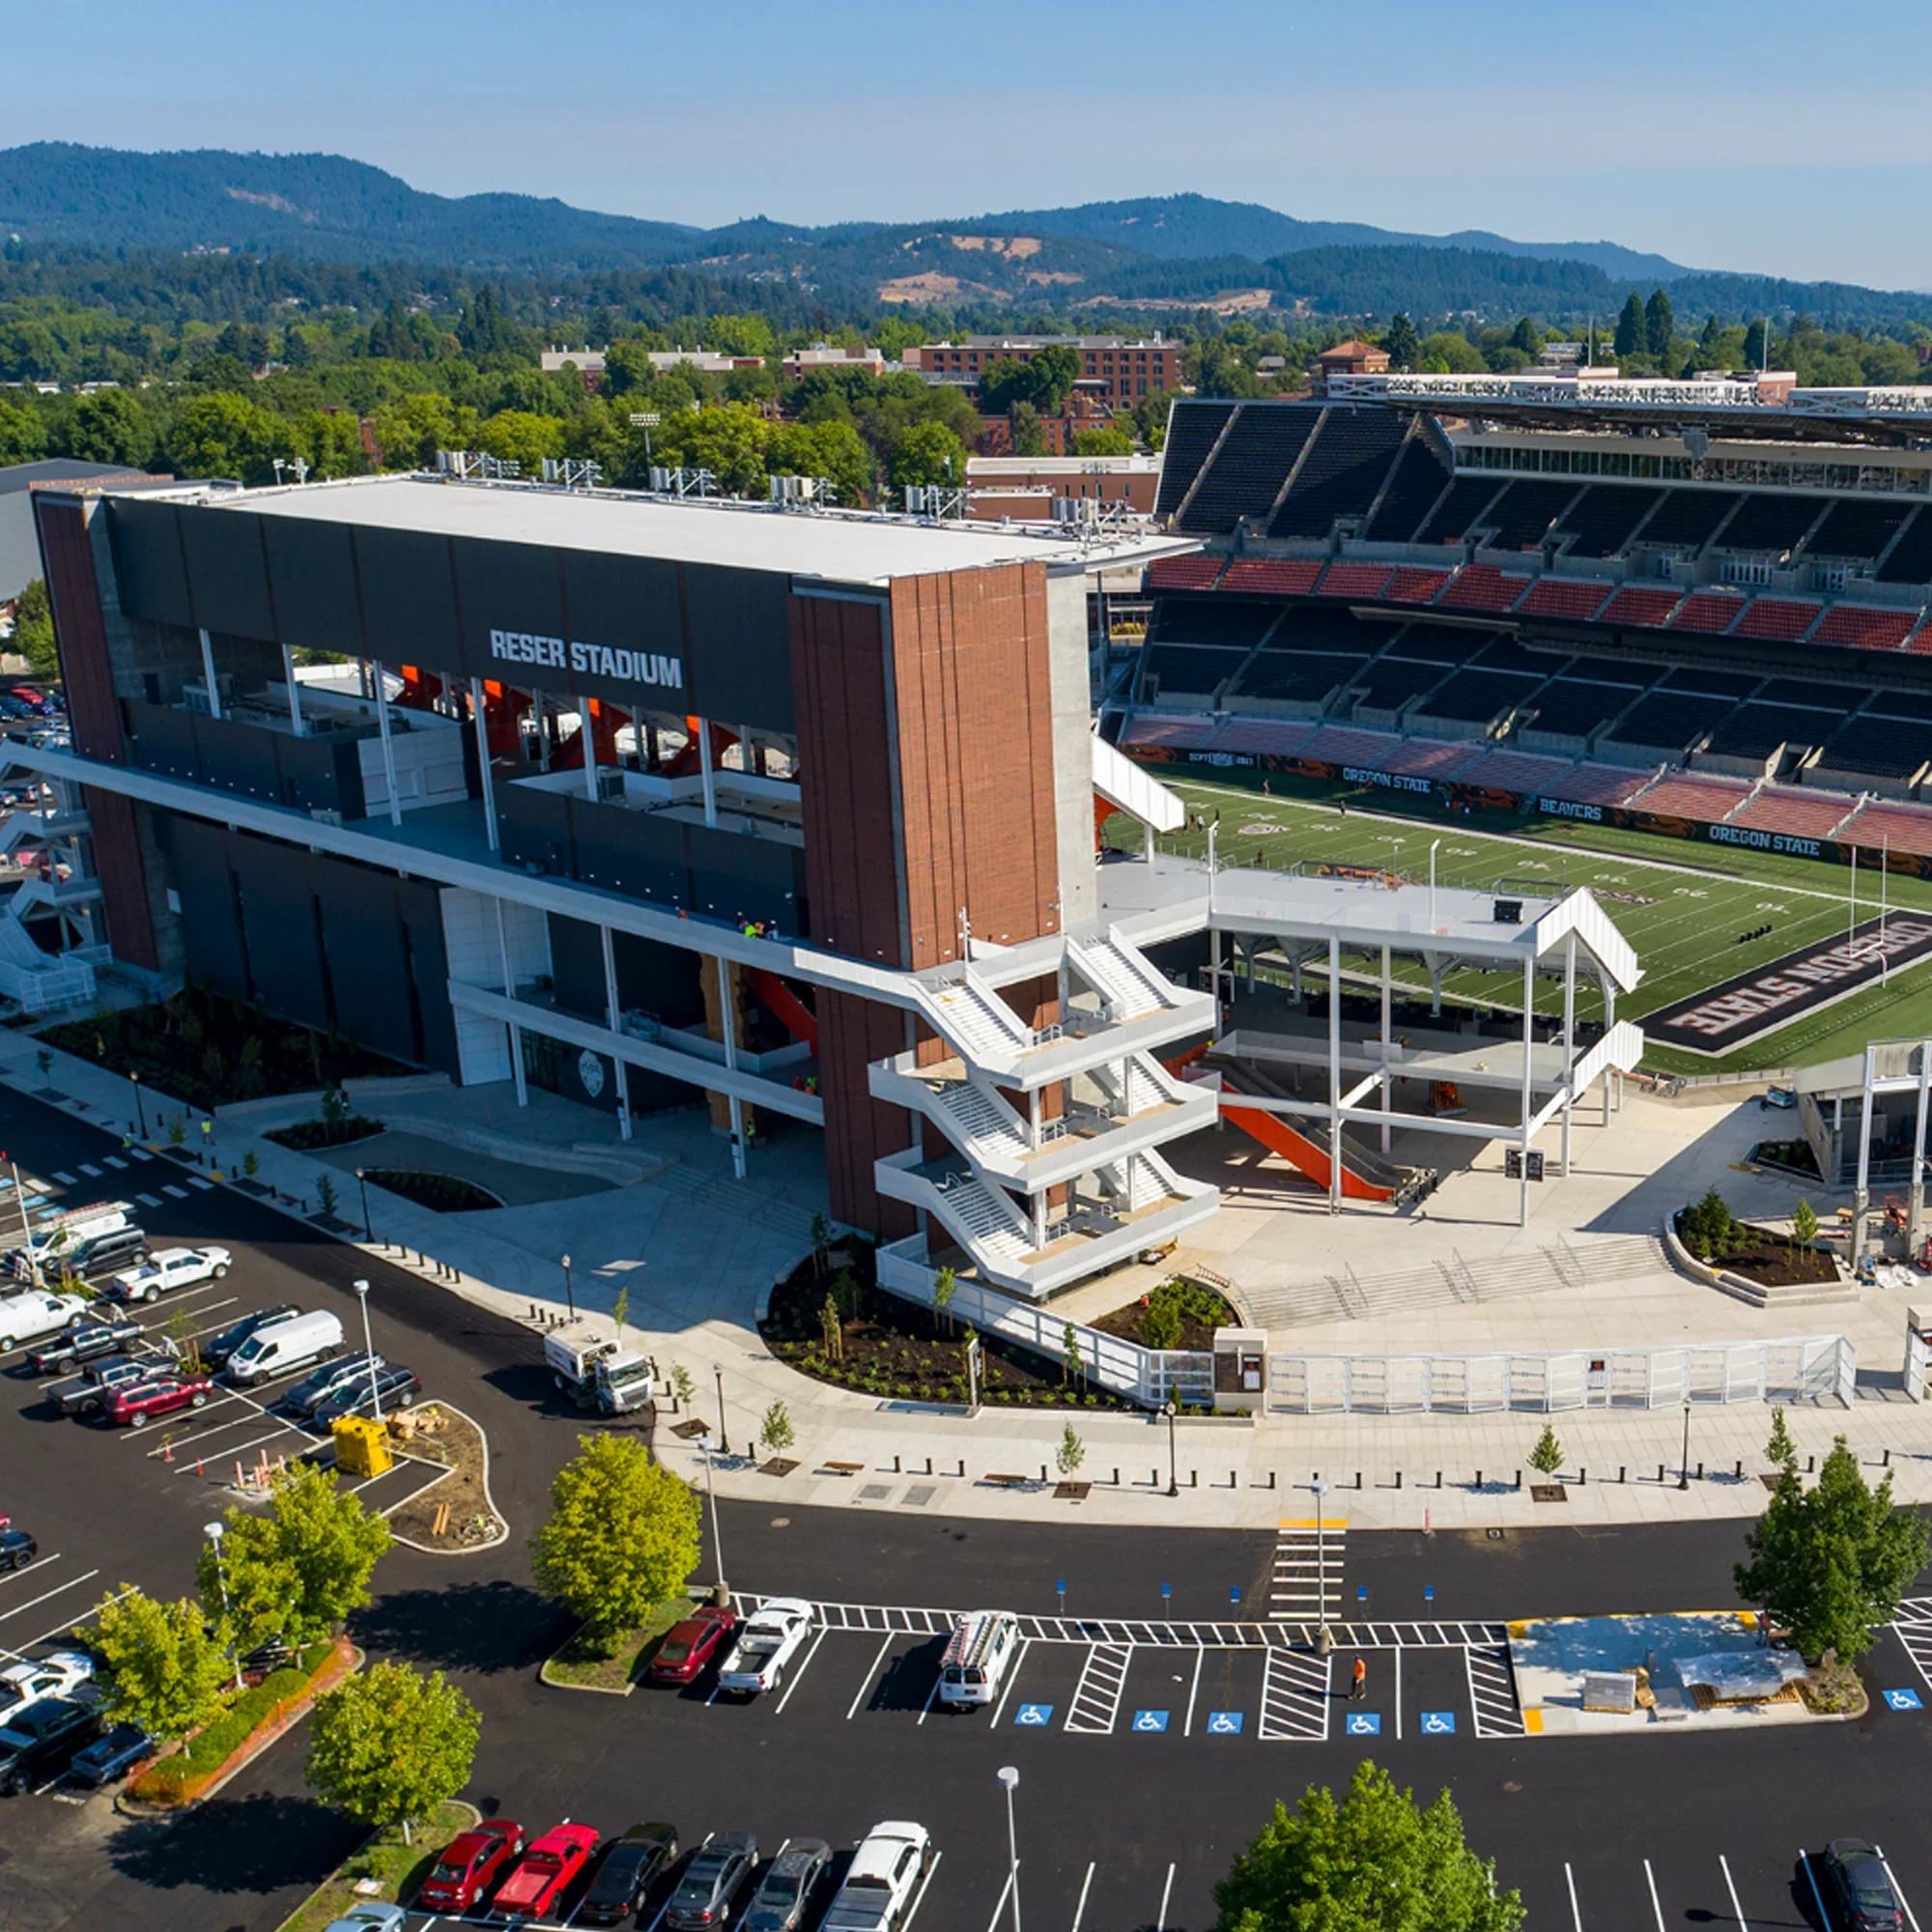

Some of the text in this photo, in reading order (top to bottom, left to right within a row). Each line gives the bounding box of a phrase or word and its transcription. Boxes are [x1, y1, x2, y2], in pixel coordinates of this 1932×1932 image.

[490, 629, 683, 689] RESER STADIUM
[1343, 766, 1432, 793] OREGON STATE
[1539, 798, 1602, 820] BEAVERS
[1709, 825, 1821, 856] OREGON STATE
[1663, 976, 1815, 1036] STATE
